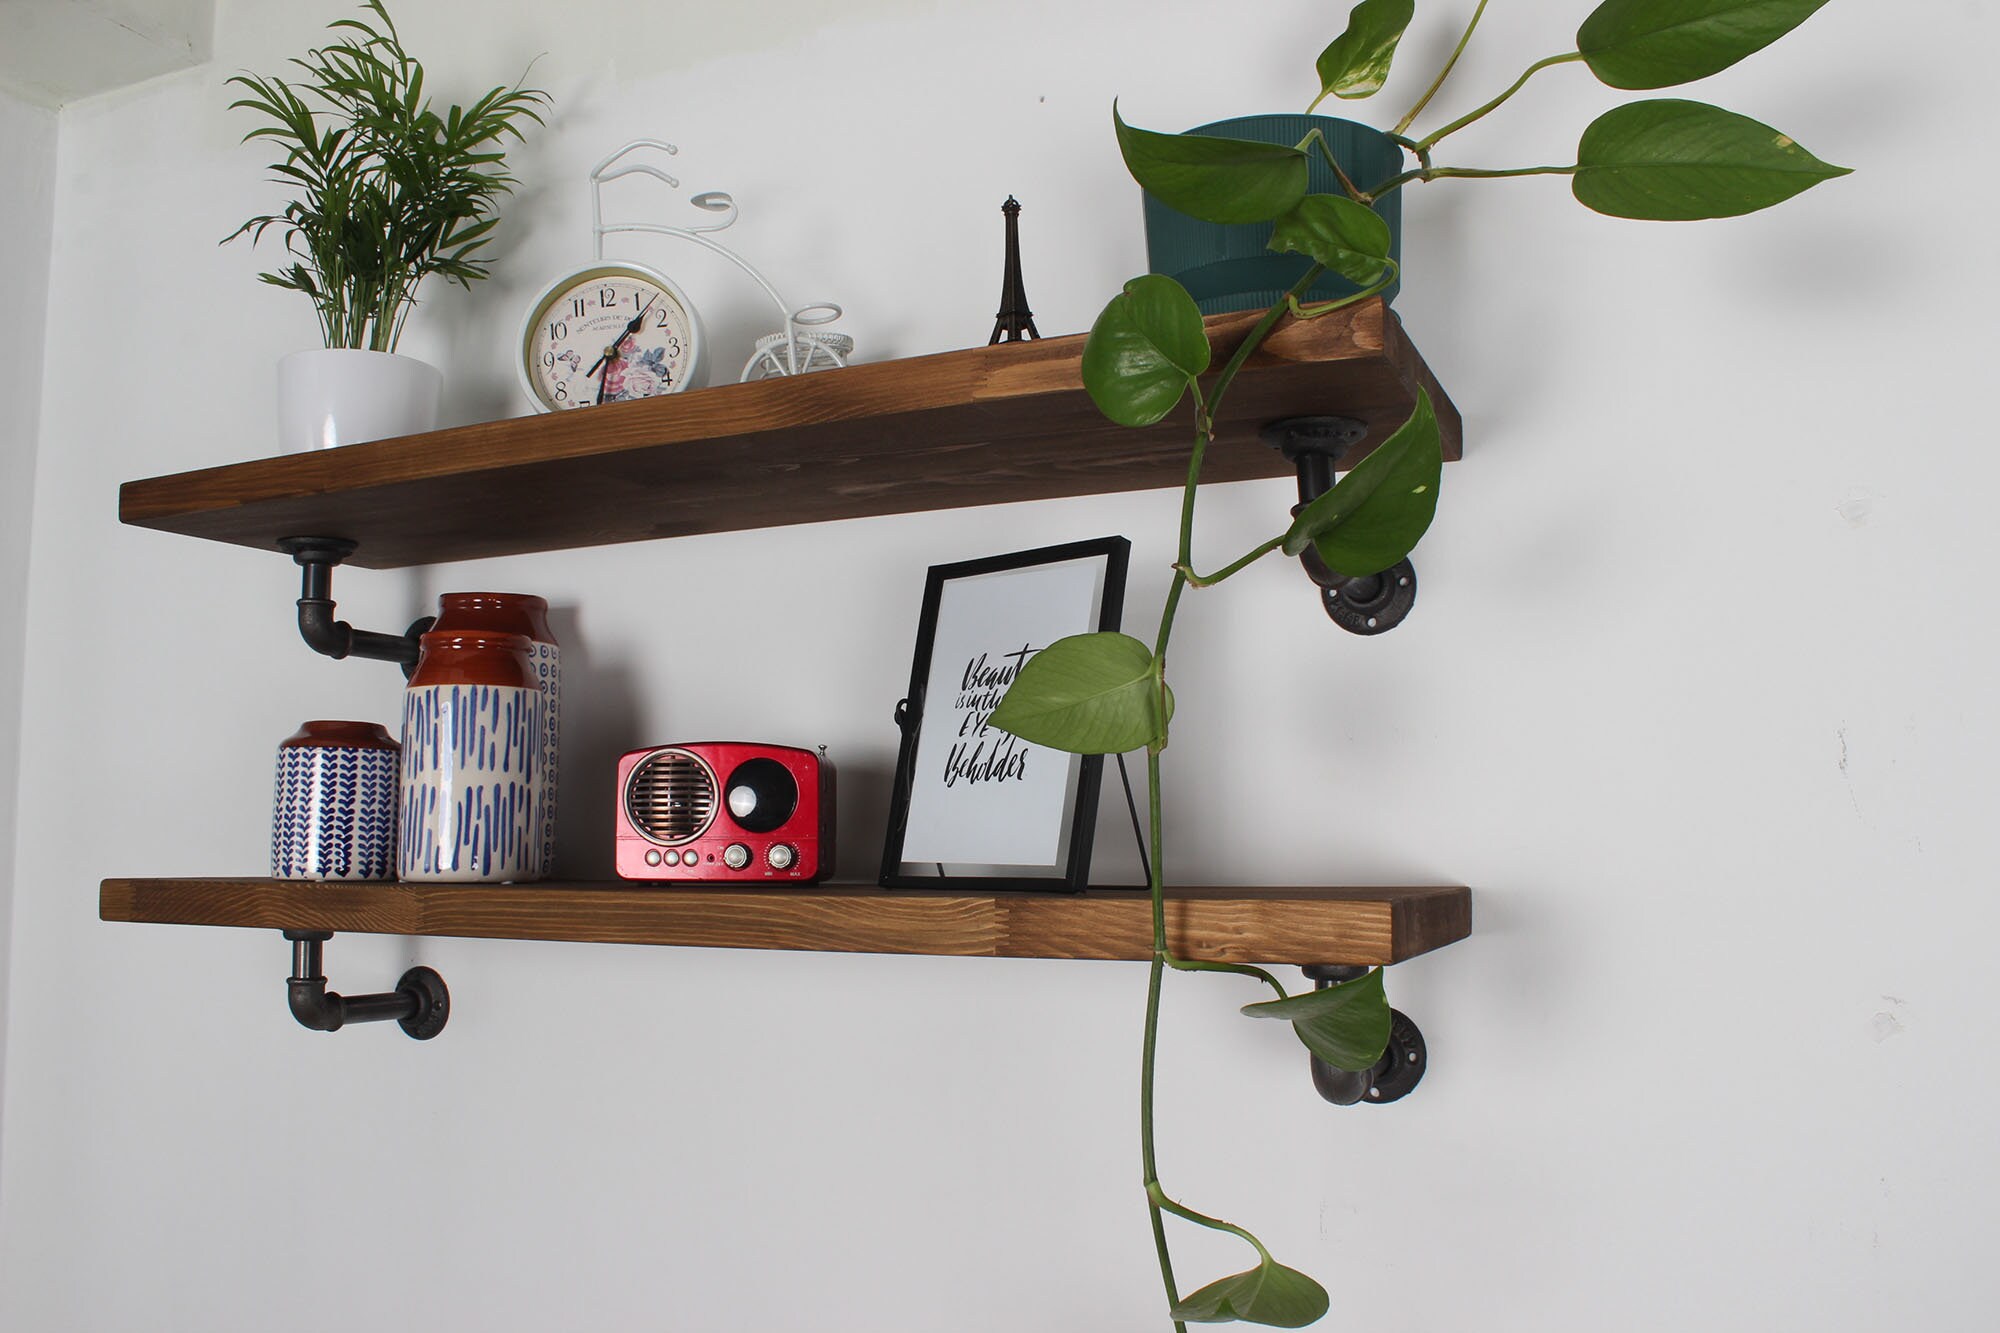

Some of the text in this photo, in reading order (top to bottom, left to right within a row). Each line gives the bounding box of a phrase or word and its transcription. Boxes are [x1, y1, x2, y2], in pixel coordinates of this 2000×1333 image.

[573, 298, 585, 318] 11
[600, 288, 616, 308] 12
[634, 292, 640, 311] 1
[655, 309, 668, 328] 2
[550, 322, 567, 341] 10
[668, 336, 680, 358] 3
[543, 352, 555, 375] 9
[661, 368, 673, 387] 4
[555, 381, 568, 401] 8
[961, 643, 1044, 691] Beaut
[982, 688, 1003, 711] th
[943, 737, 1029, 788] Beholder
